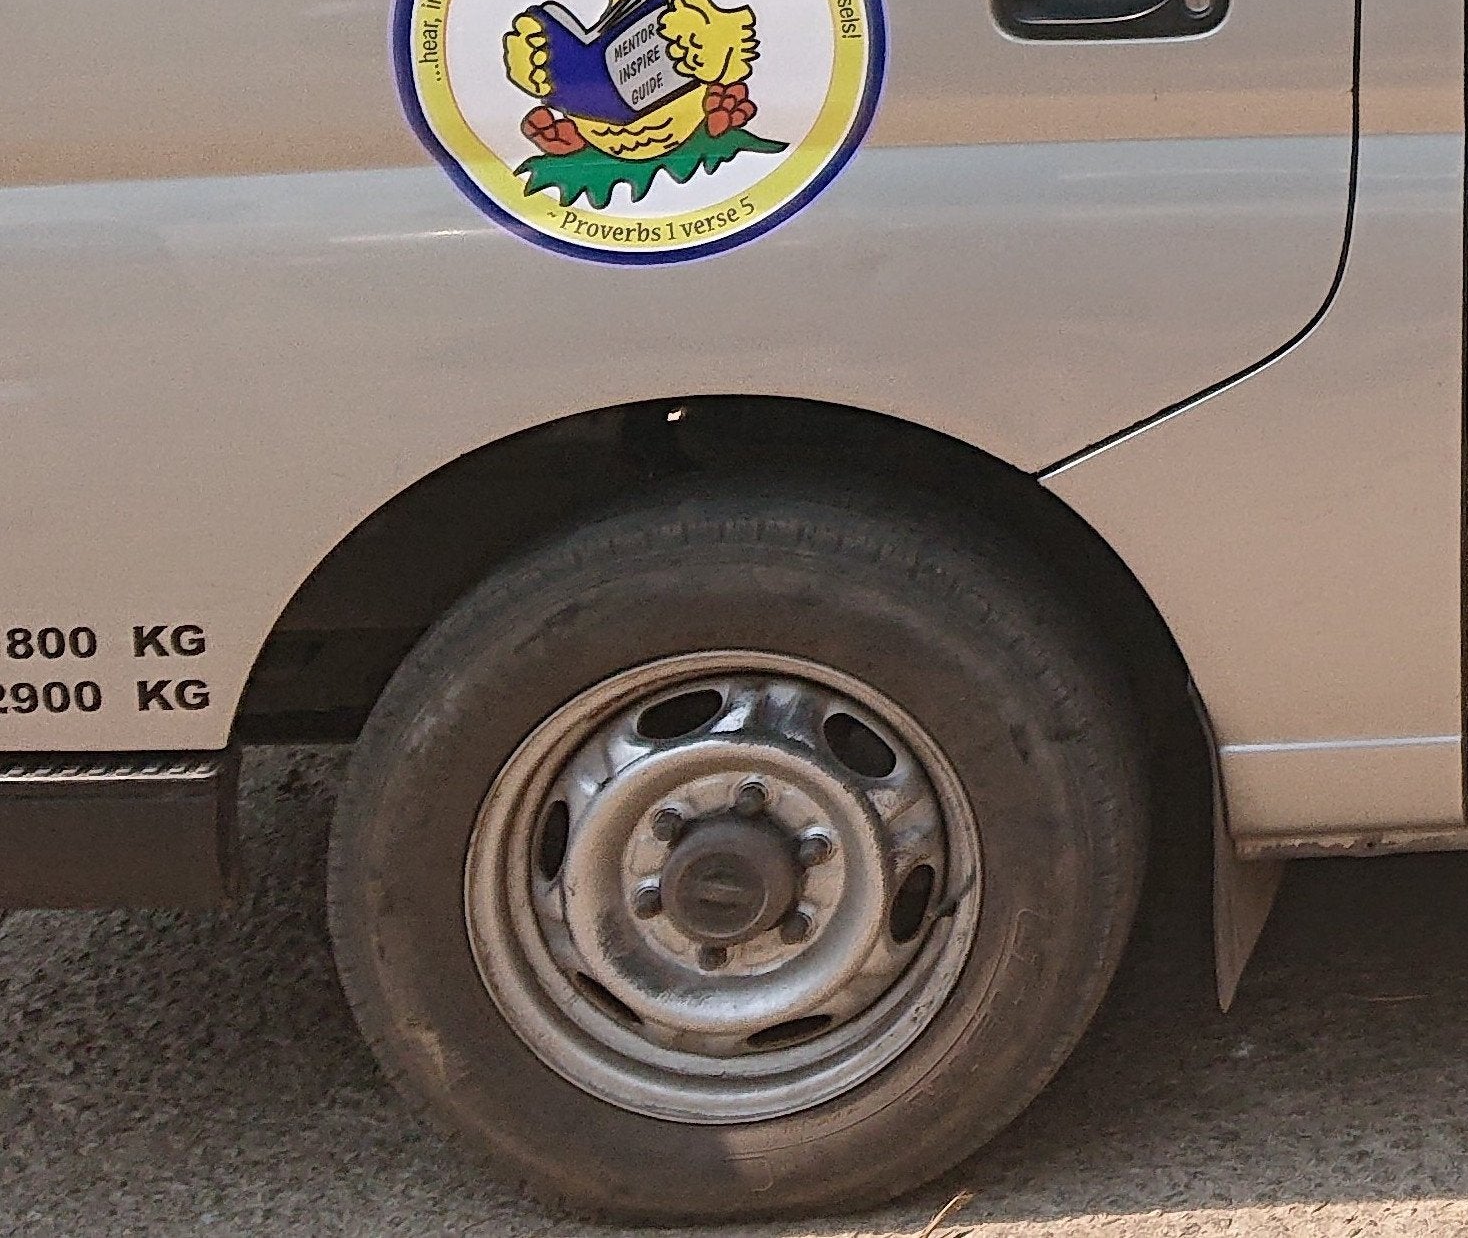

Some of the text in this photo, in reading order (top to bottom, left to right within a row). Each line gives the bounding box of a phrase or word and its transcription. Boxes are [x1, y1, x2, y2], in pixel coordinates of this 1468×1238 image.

[613, 22, 656, 62] MENTOR
[618, 44, 661, 85] INSPIRE
[559, 210, 662, 243] Proverbs
[679, 207, 741, 238] verse
[738, 195, 756, 216] 5
[132, 624, 206, 658] KG
[0, 679, 210, 714] 900 KG
